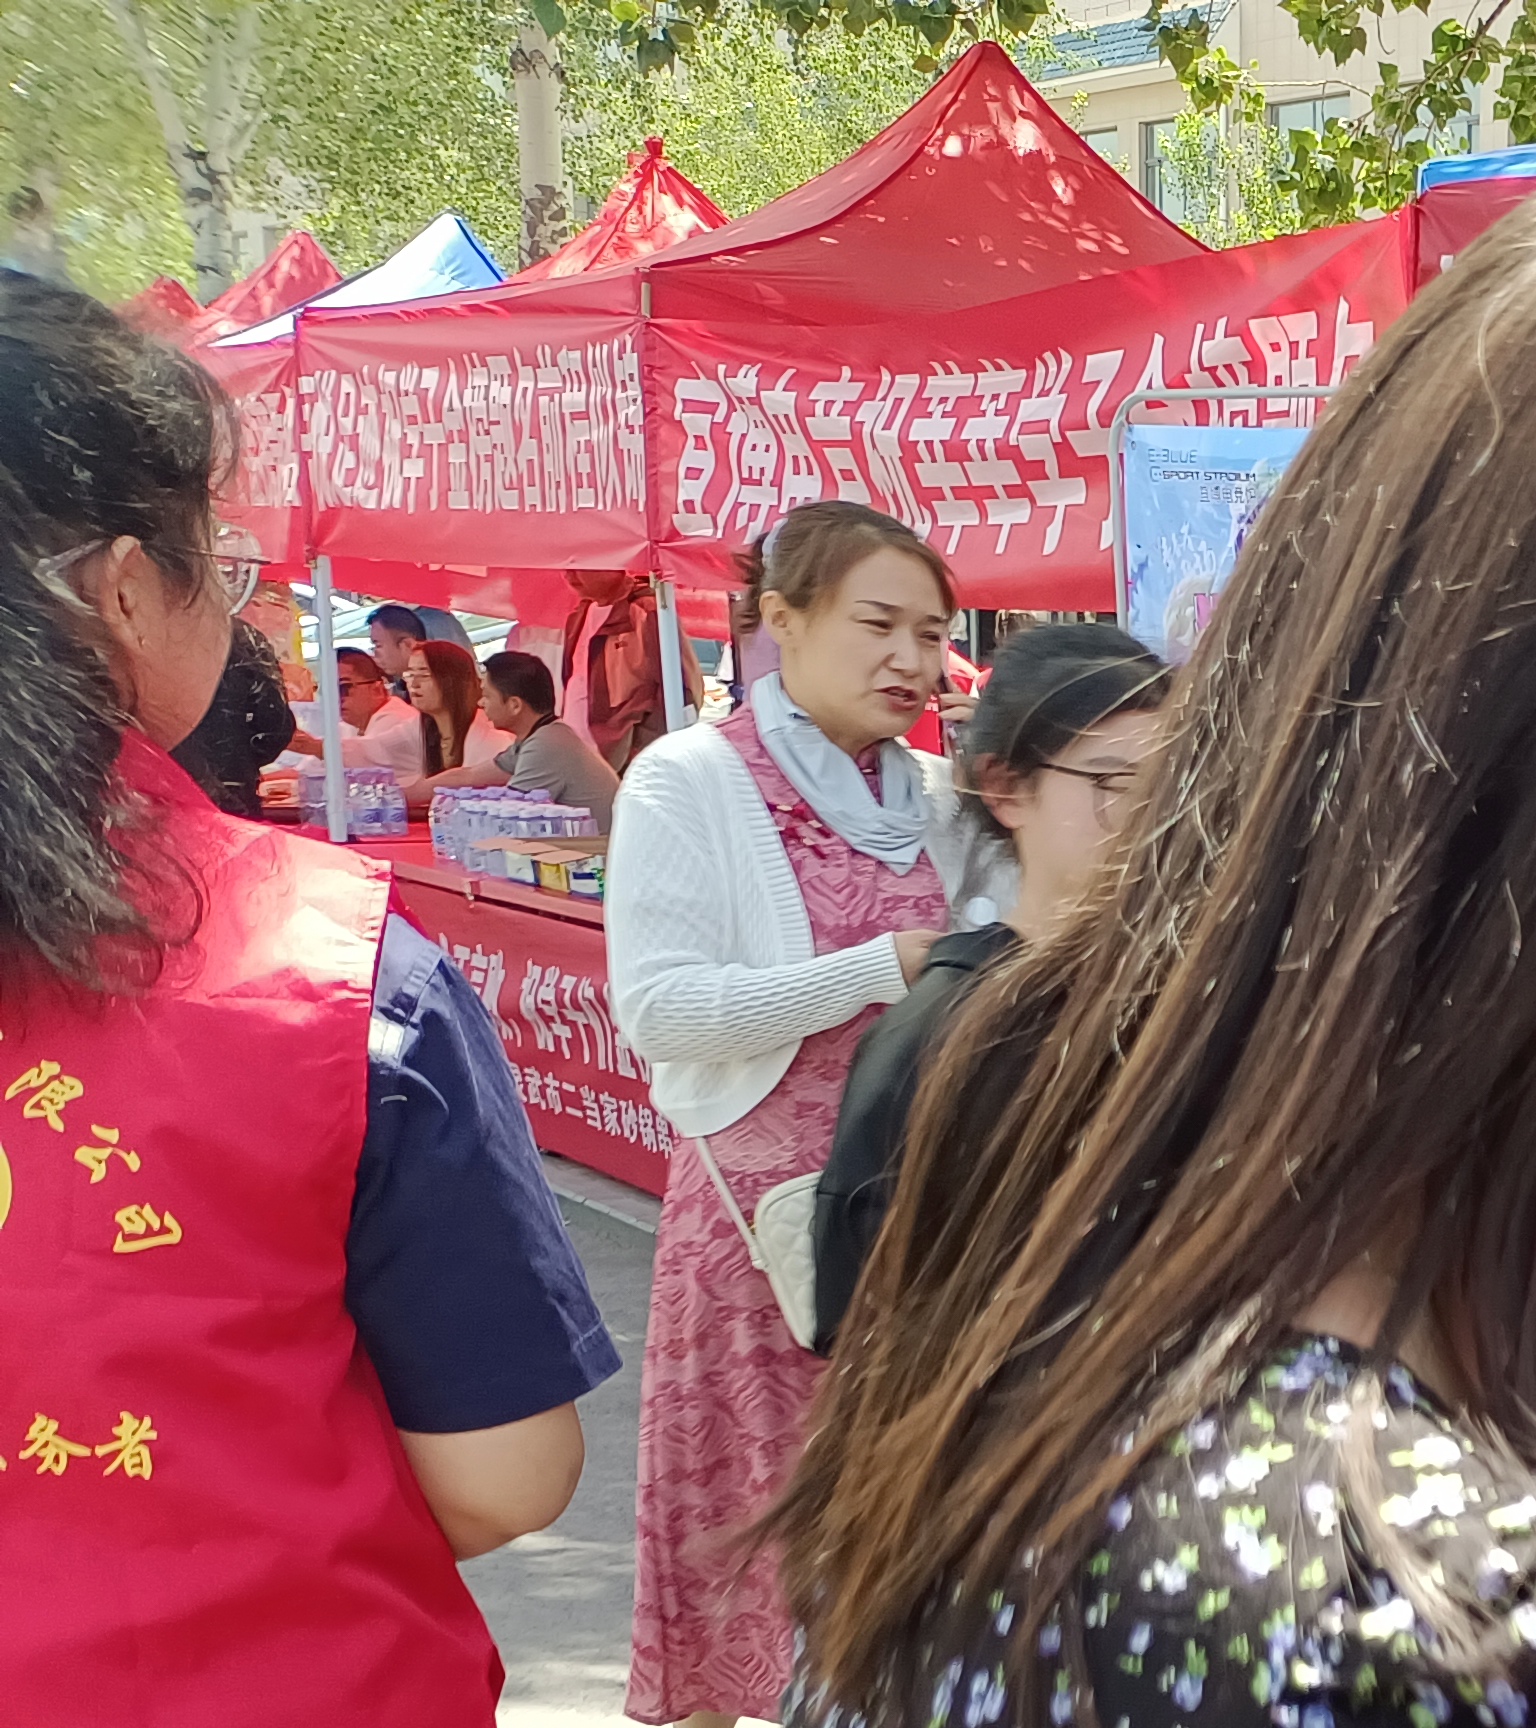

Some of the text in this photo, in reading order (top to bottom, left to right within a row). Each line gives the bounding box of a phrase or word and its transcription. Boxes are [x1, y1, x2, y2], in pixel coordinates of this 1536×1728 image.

[509, 1062, 678, 1160] 灵武市二当家砂锅串
[0, 1410, 159, 1481] 务者
